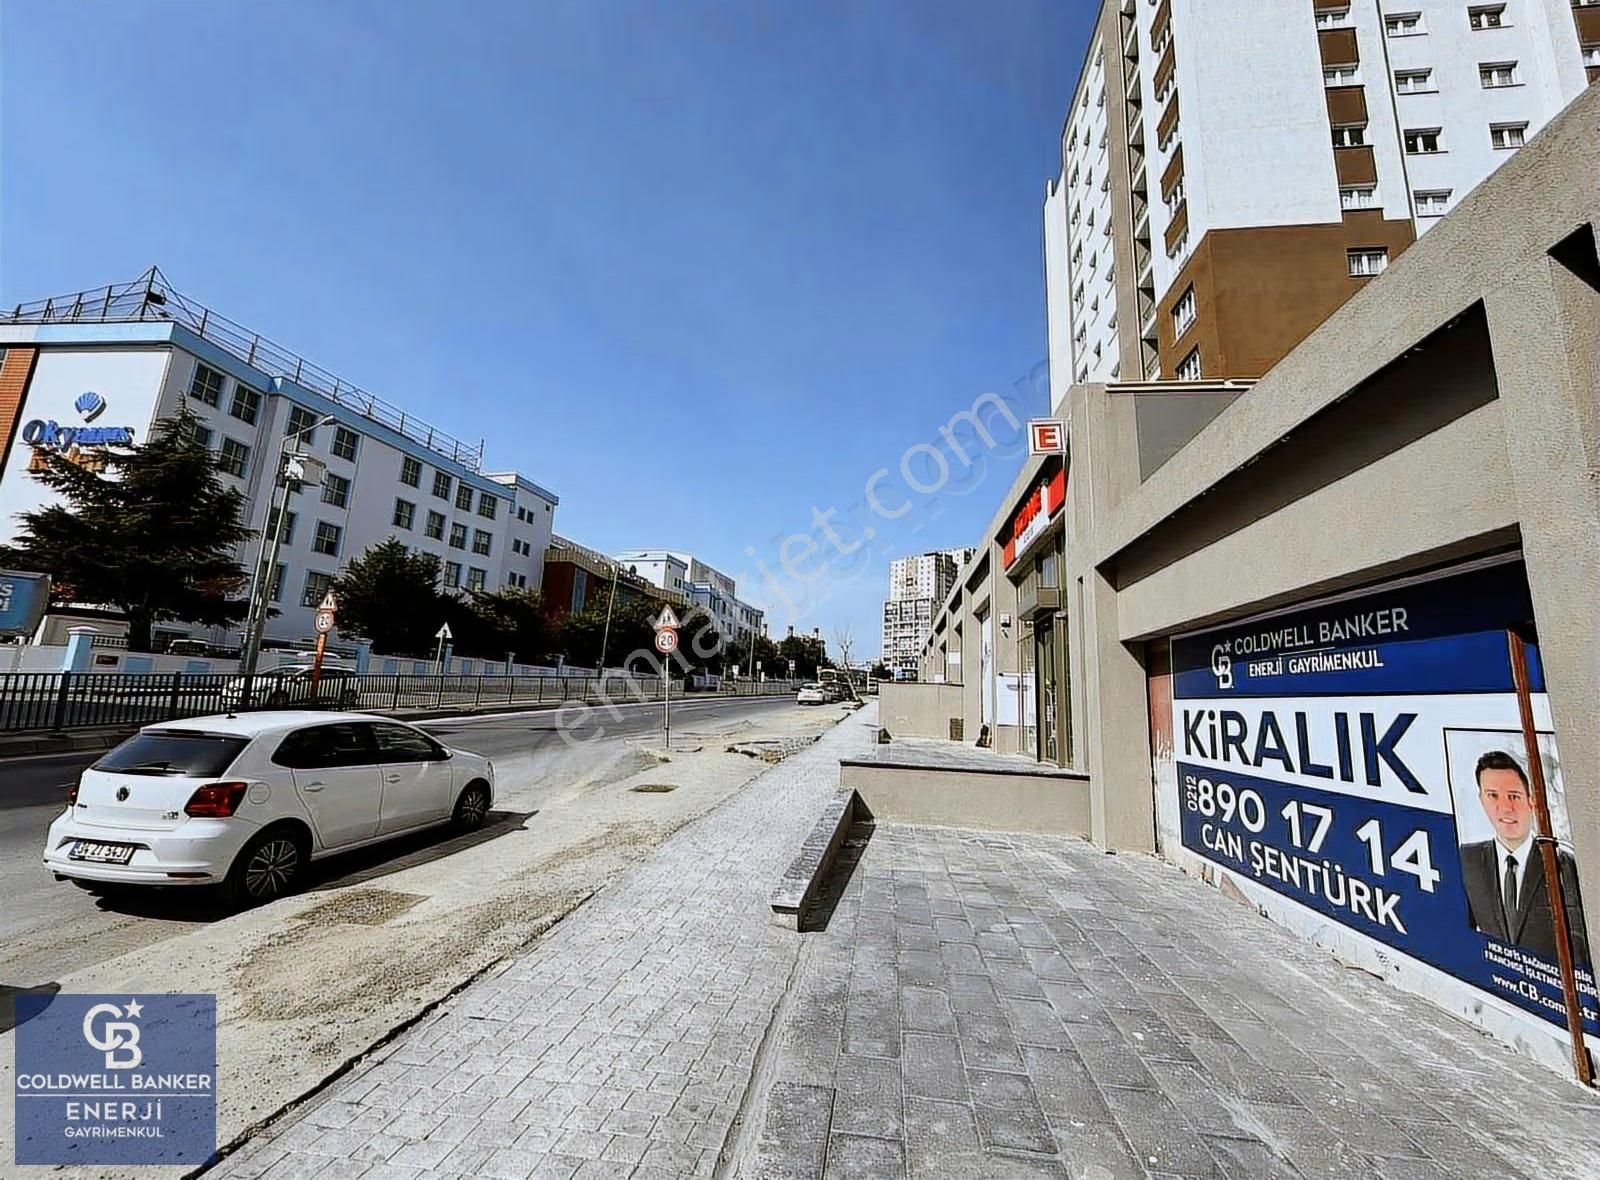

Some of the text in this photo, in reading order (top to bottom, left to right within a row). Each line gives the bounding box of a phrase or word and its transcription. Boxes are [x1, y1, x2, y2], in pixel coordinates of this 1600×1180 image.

[1039, 427, 1058, 448] E
[660, 635, 673, 646] 20
[1235, 607, 1409, 655] COLDWELL BANKER
[1249, 650, 1384, 677] ENERJİ GAYRİMENKUL
[1186, 775, 1198, 812] 0212
[1198, 778, 1441, 894] 890 17 14
[1202, 823, 1408, 936] CAN ŞENTÜRK
